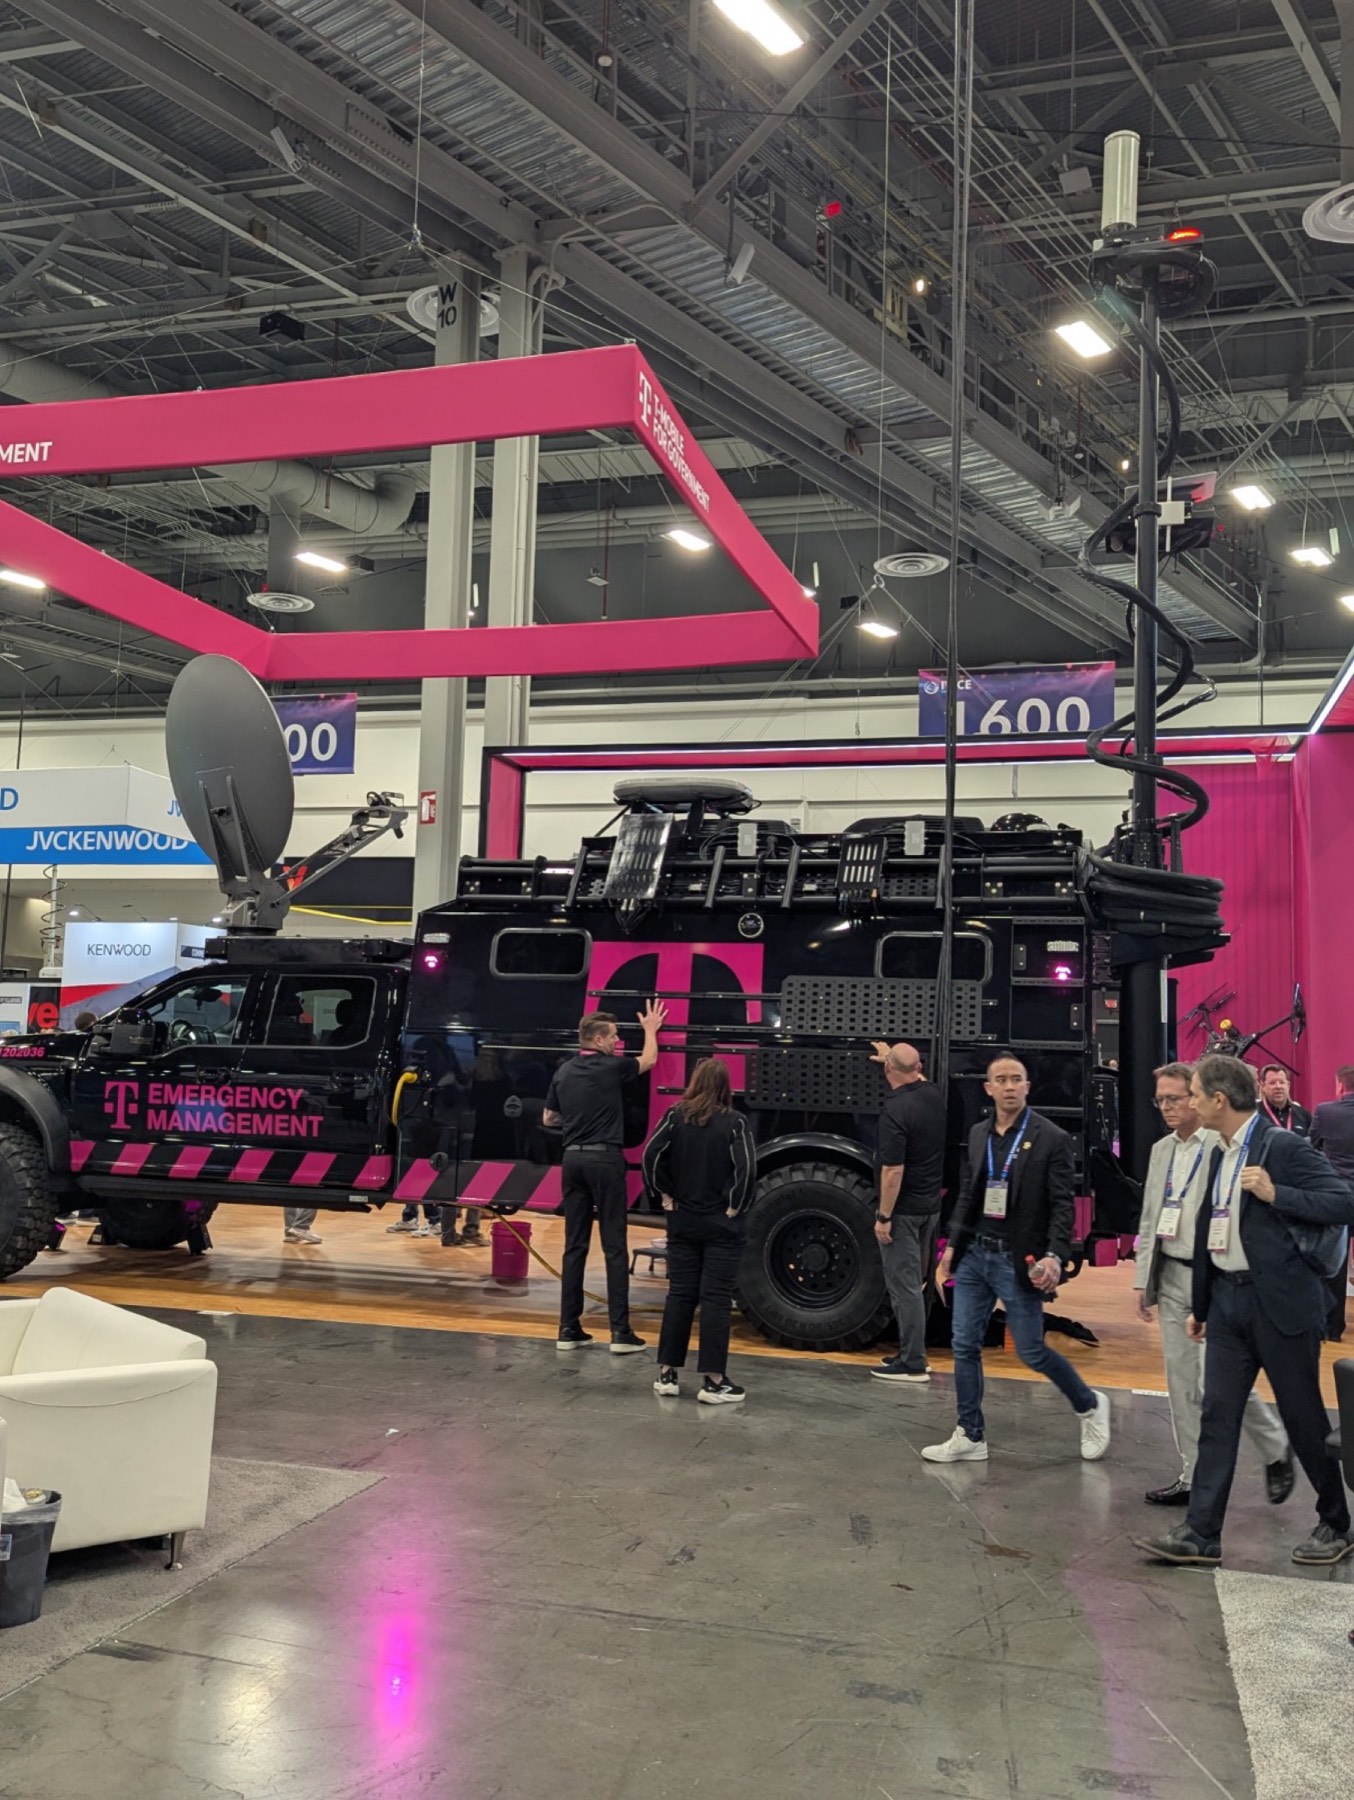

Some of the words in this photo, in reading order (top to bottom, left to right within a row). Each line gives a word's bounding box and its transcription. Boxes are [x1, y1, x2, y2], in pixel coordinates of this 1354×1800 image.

[440, 282, 457, 304] W
[437, 306, 457, 328] 10
[653, 394, 685, 456] T-MOBILE
[0, 441, 53, 463] MENT
[652, 416, 668, 453] FOR
[667, 439, 710, 513] GOVERNMENT
[941, 679, 973, 690] ICE
[25, 829, 188, 851] JVCKENWOOD
[87, 943, 152, 956] KENWOOD
[148, 1083, 305, 1110] EMERGENCY
[147, 1110, 324, 1137] MANAGEMENT
